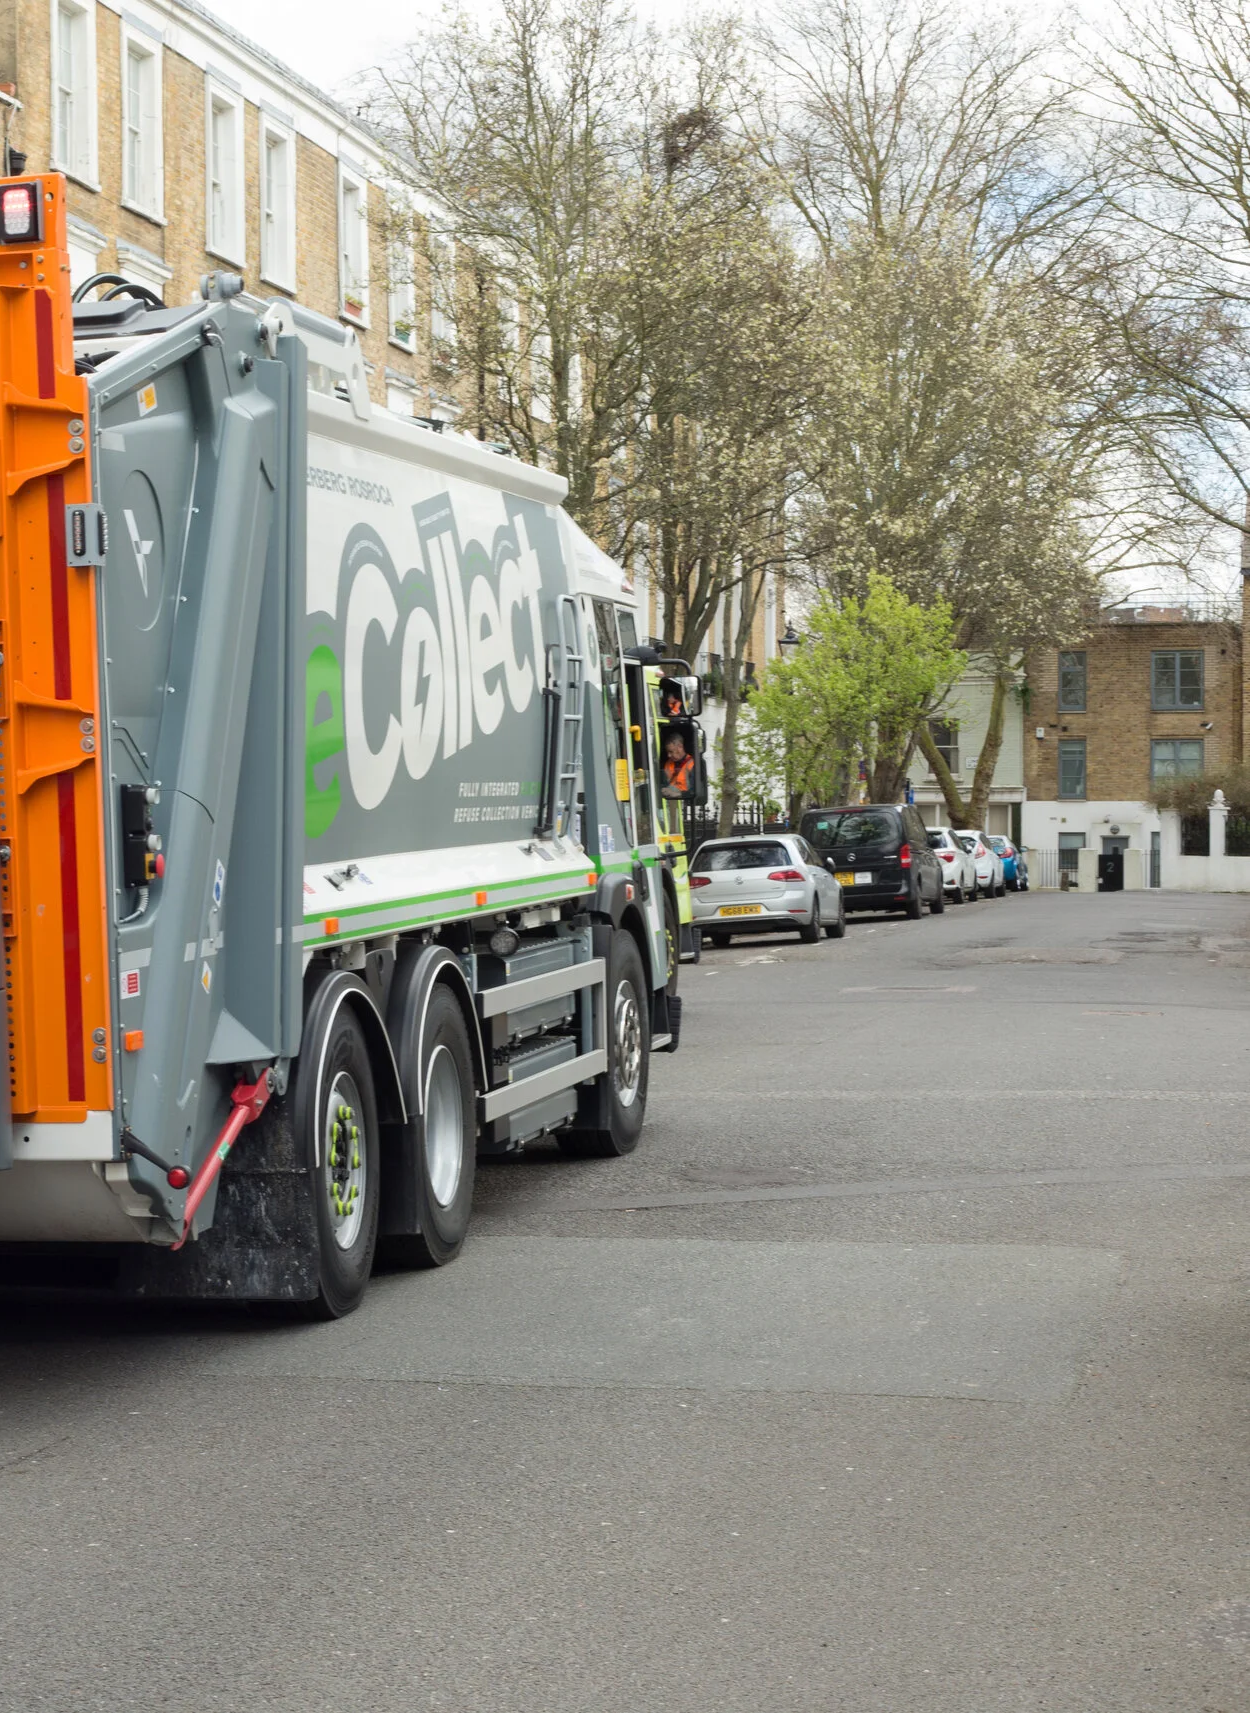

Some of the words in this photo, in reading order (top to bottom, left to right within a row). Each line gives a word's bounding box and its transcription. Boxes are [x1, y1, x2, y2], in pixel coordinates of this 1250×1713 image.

[458, 782, 480, 797] FULLY
[481, 781, 520, 797] INTEGRATED
[453, 807, 480, 823] REFUSE
[481, 806, 520, 821] COLLECTION
[1106, 861, 1115, 873] 2
